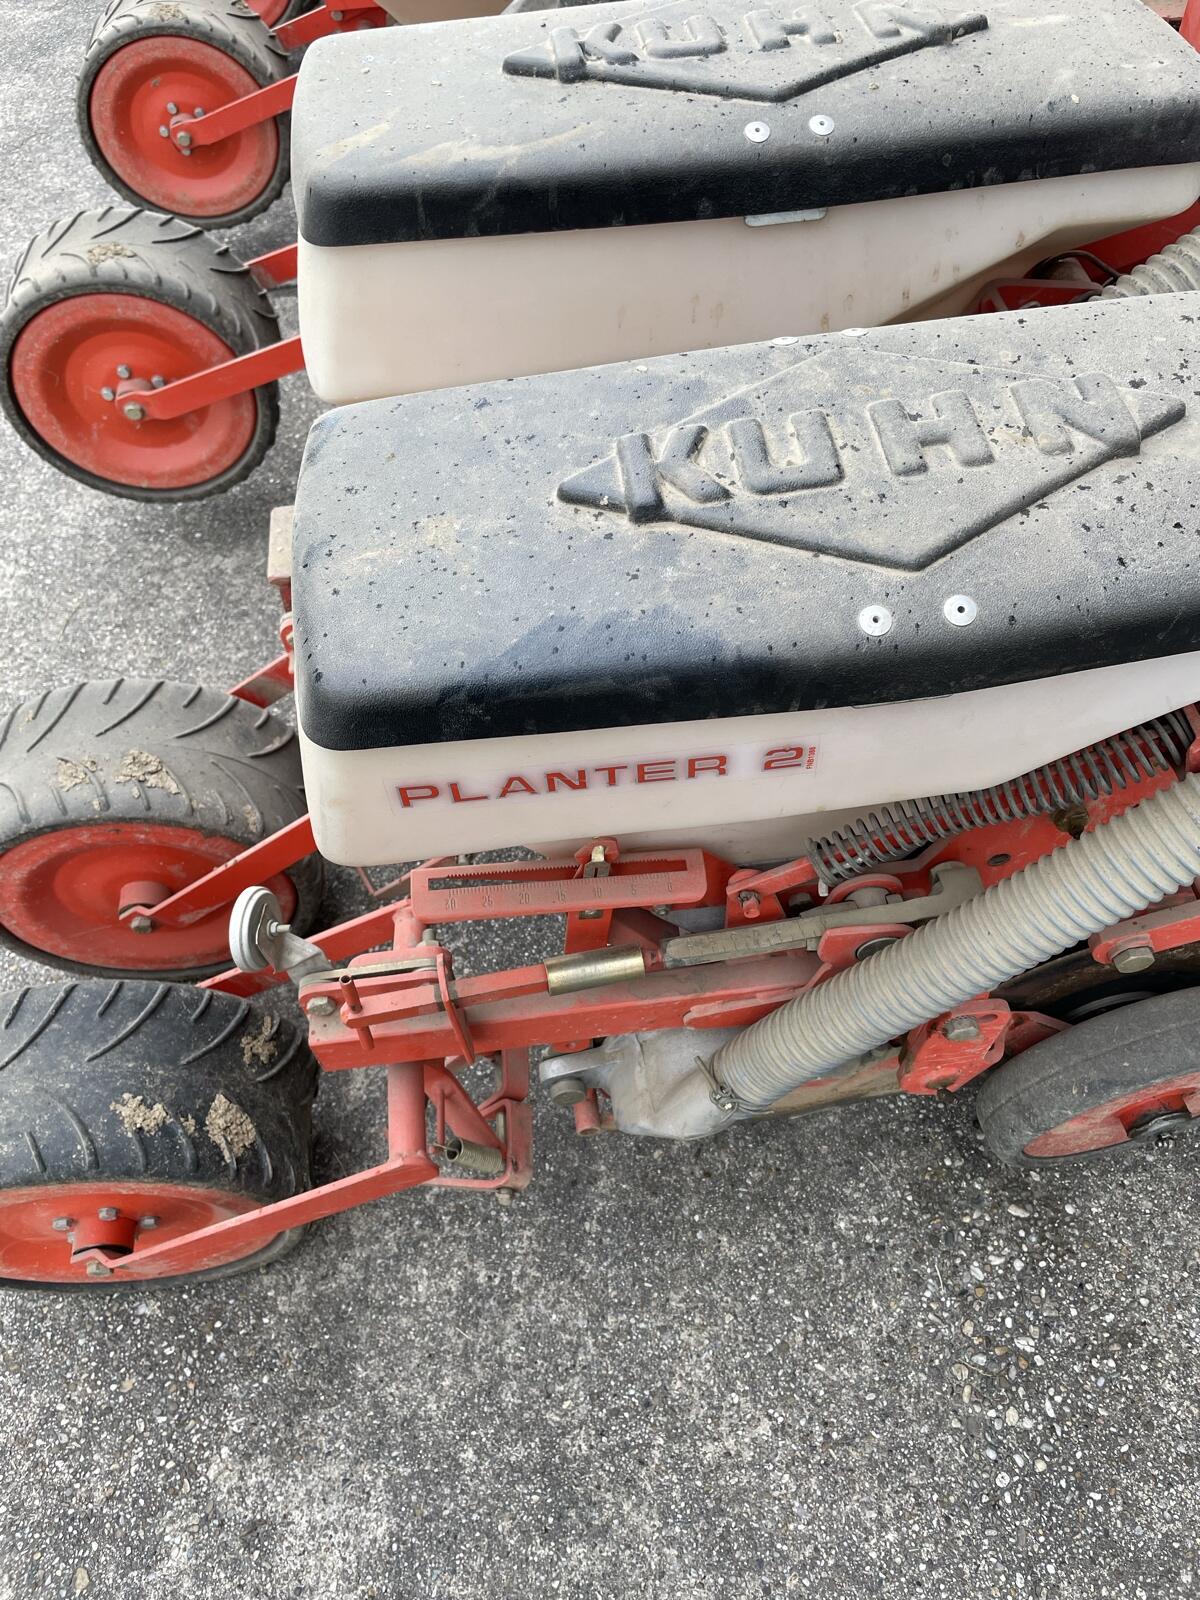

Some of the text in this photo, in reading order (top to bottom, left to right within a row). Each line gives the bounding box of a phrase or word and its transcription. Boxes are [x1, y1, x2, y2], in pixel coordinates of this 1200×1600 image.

[617, 372, 1141, 524] KUHN
[397, 745, 804, 808] PLANTER 2
